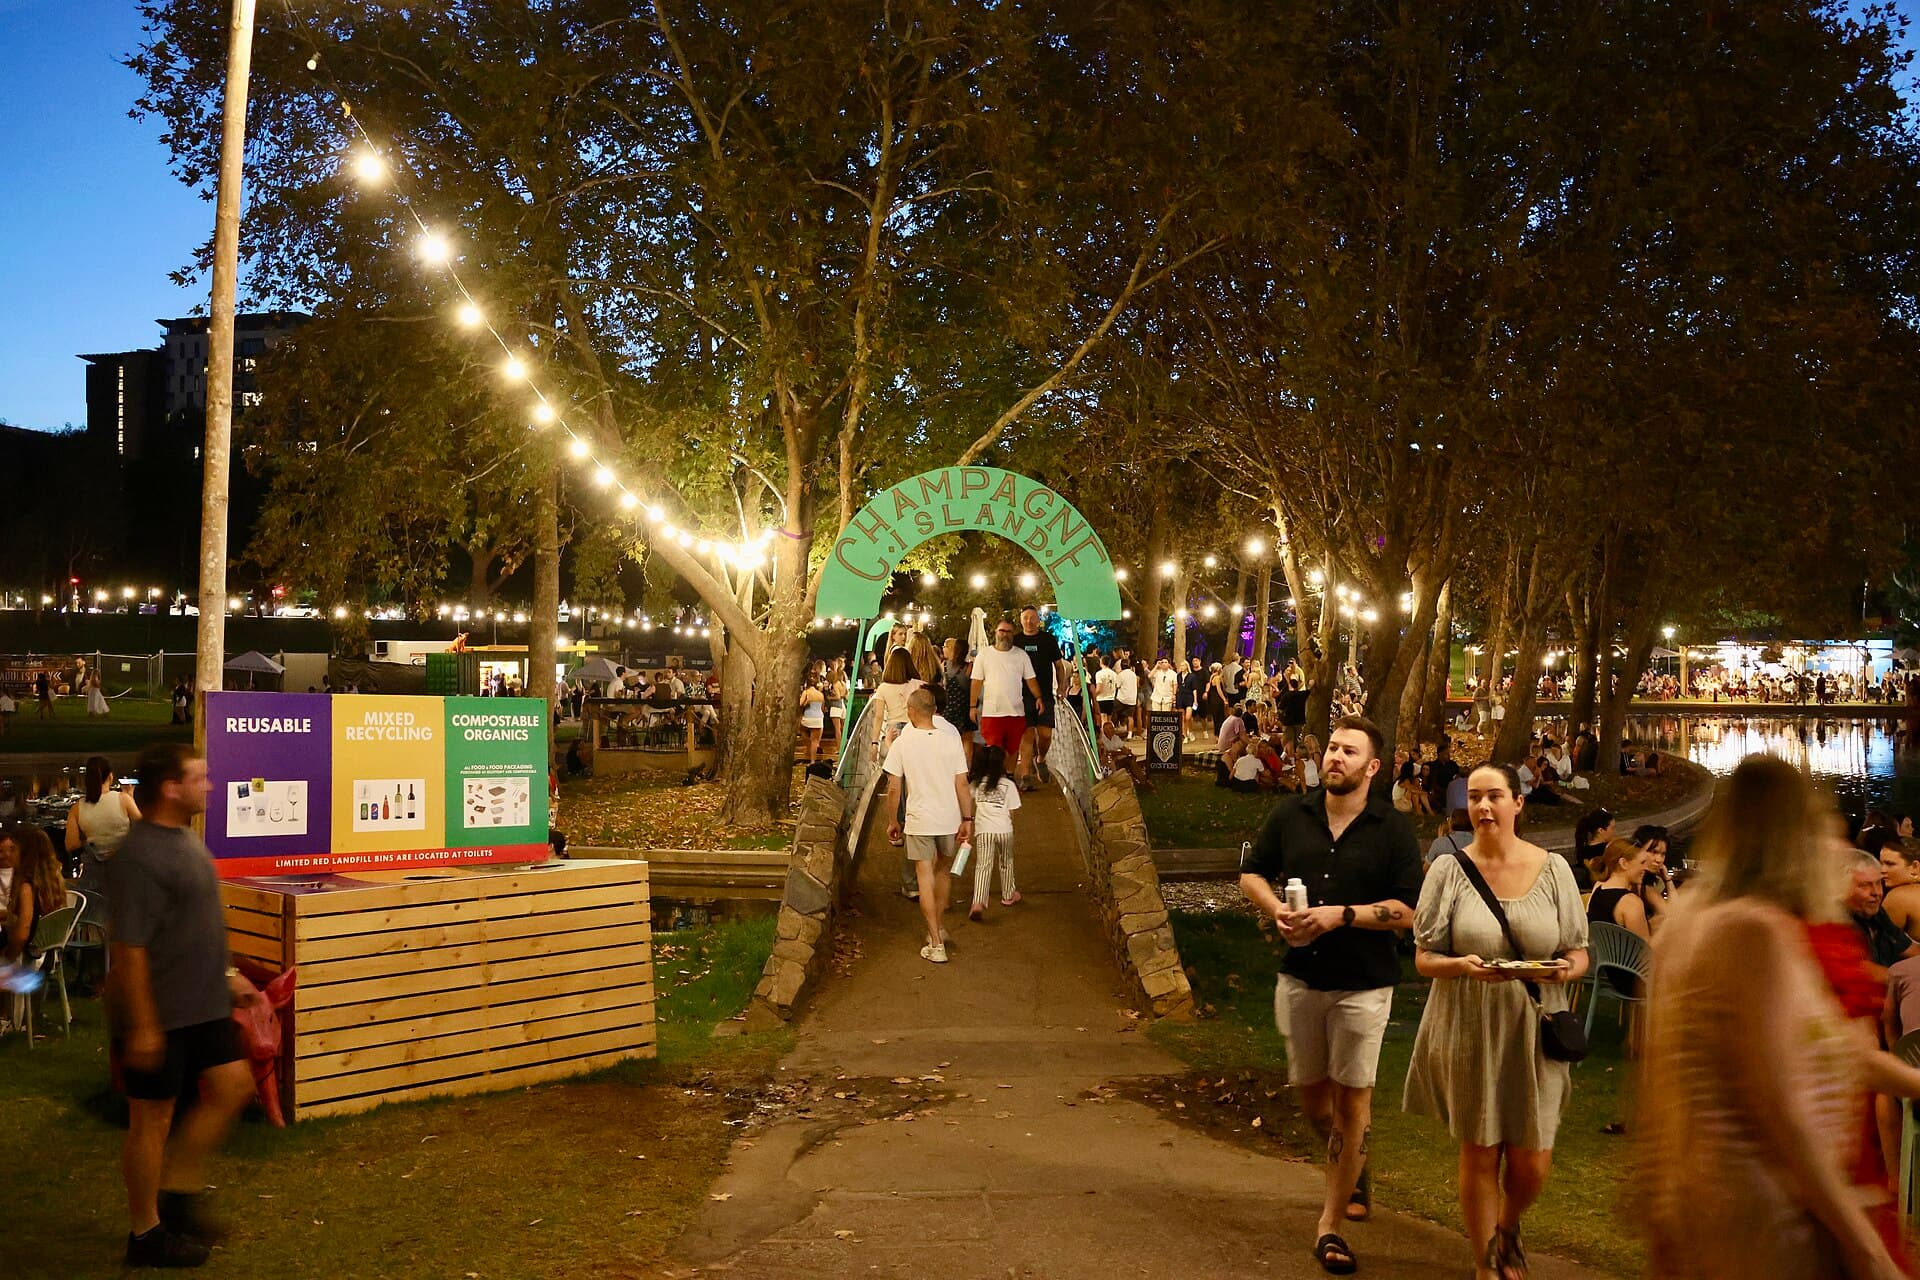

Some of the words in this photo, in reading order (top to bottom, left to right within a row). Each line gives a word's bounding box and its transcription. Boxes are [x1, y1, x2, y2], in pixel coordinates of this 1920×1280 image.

[835, 468, 1107, 585] CHAMPAGNE
[889, 504, 1049, 552] ISLAND
[226, 718, 311, 733] REUSABLE
[364, 711, 415, 726] MIXED
[452, 715, 539, 727] COMPOSTABLE
[345, 726, 433, 741] RECYCLING
[464, 729, 529, 741] ORGANICS
[275, 858, 310, 867] LIMITED
[313, 857, 329, 865] RED
[332, 855, 372, 864] LANDFILL
[374, 854, 393, 862] BINS
[414, 852, 449, 860] LOCATED
[464, 850, 493, 858] TOILETS
